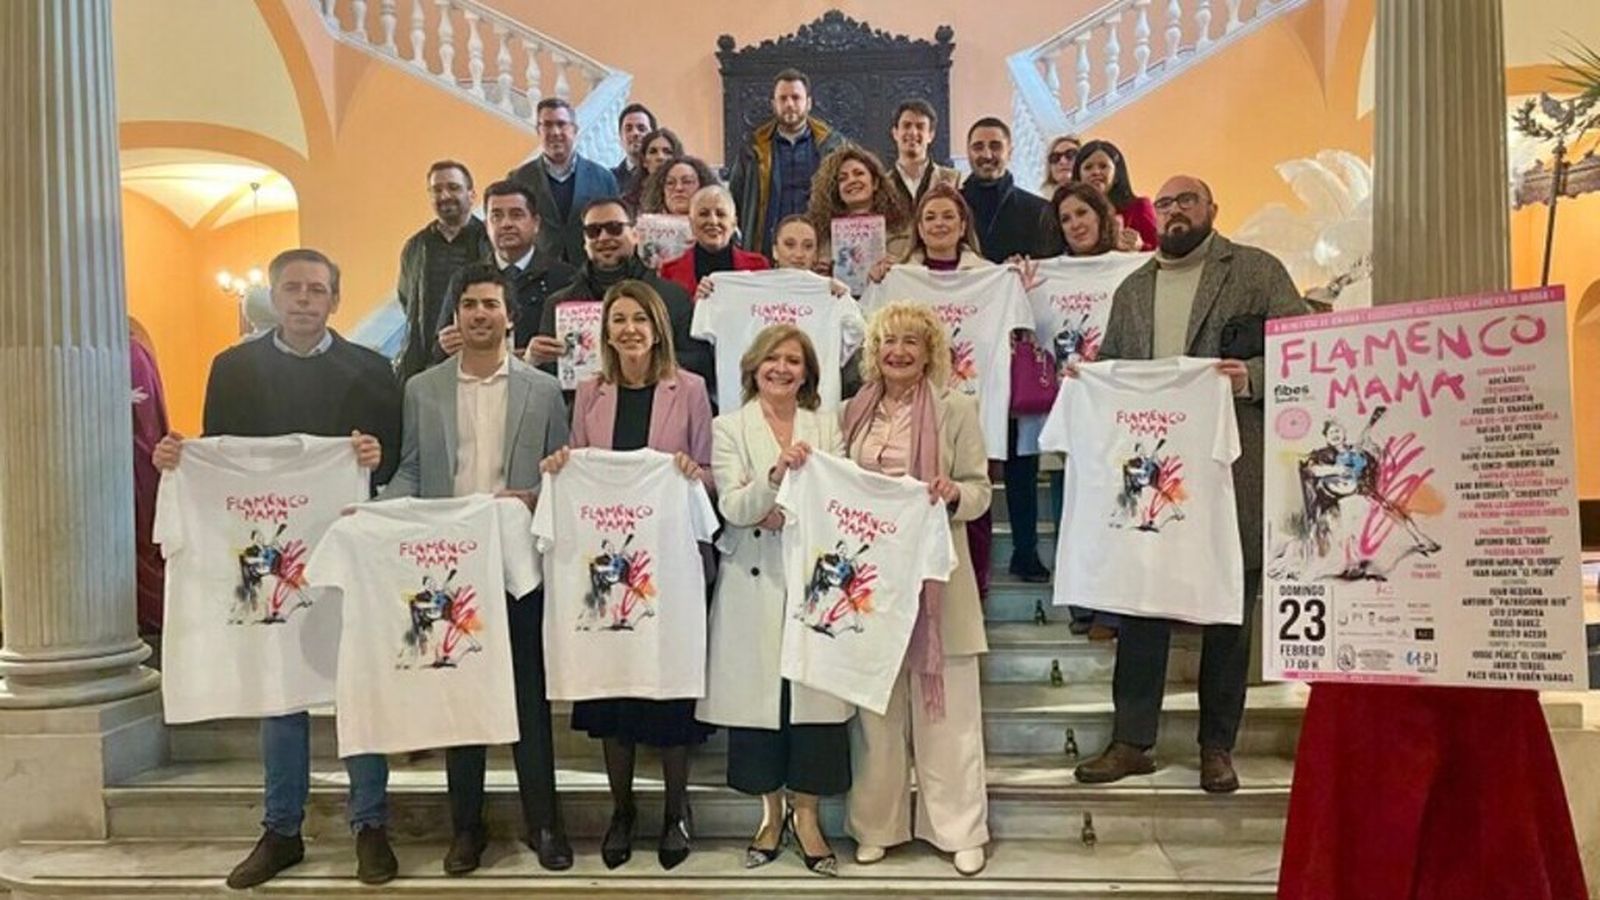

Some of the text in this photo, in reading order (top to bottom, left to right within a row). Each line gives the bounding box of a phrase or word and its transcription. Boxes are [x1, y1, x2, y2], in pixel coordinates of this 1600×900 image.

[1050, 292, 1107, 303] FLAMENCO
[750, 303, 812, 318] FLAMENCO
[931, 303, 978, 317] AMENCO
[1280, 314, 1547, 379] FLAMENCO
[1274, 384, 1309, 396] fibes
[1327, 369, 1466, 418] MAMA
[1116, 410, 1186, 425] FLAMENCO
[1129, 422, 1168, 438] MAMA
[226, 495, 309, 511] FLAMENCO
[245, 508, 289, 524] MAMA
[580, 503, 653, 520] FLAMENCO
[827, 499, 895, 534] FLAMENCO
[594, 518, 635, 534] MAMA
[837, 514, 875, 542] MAMA
[399, 539, 478, 555] FLAMENCO
[416, 554, 459, 569] MAMA
[1280, 585, 1326, 596] DOMINGO
[1279, 599, 1326, 642] 23
[1280, 645, 1326, 657] FEBRERO
